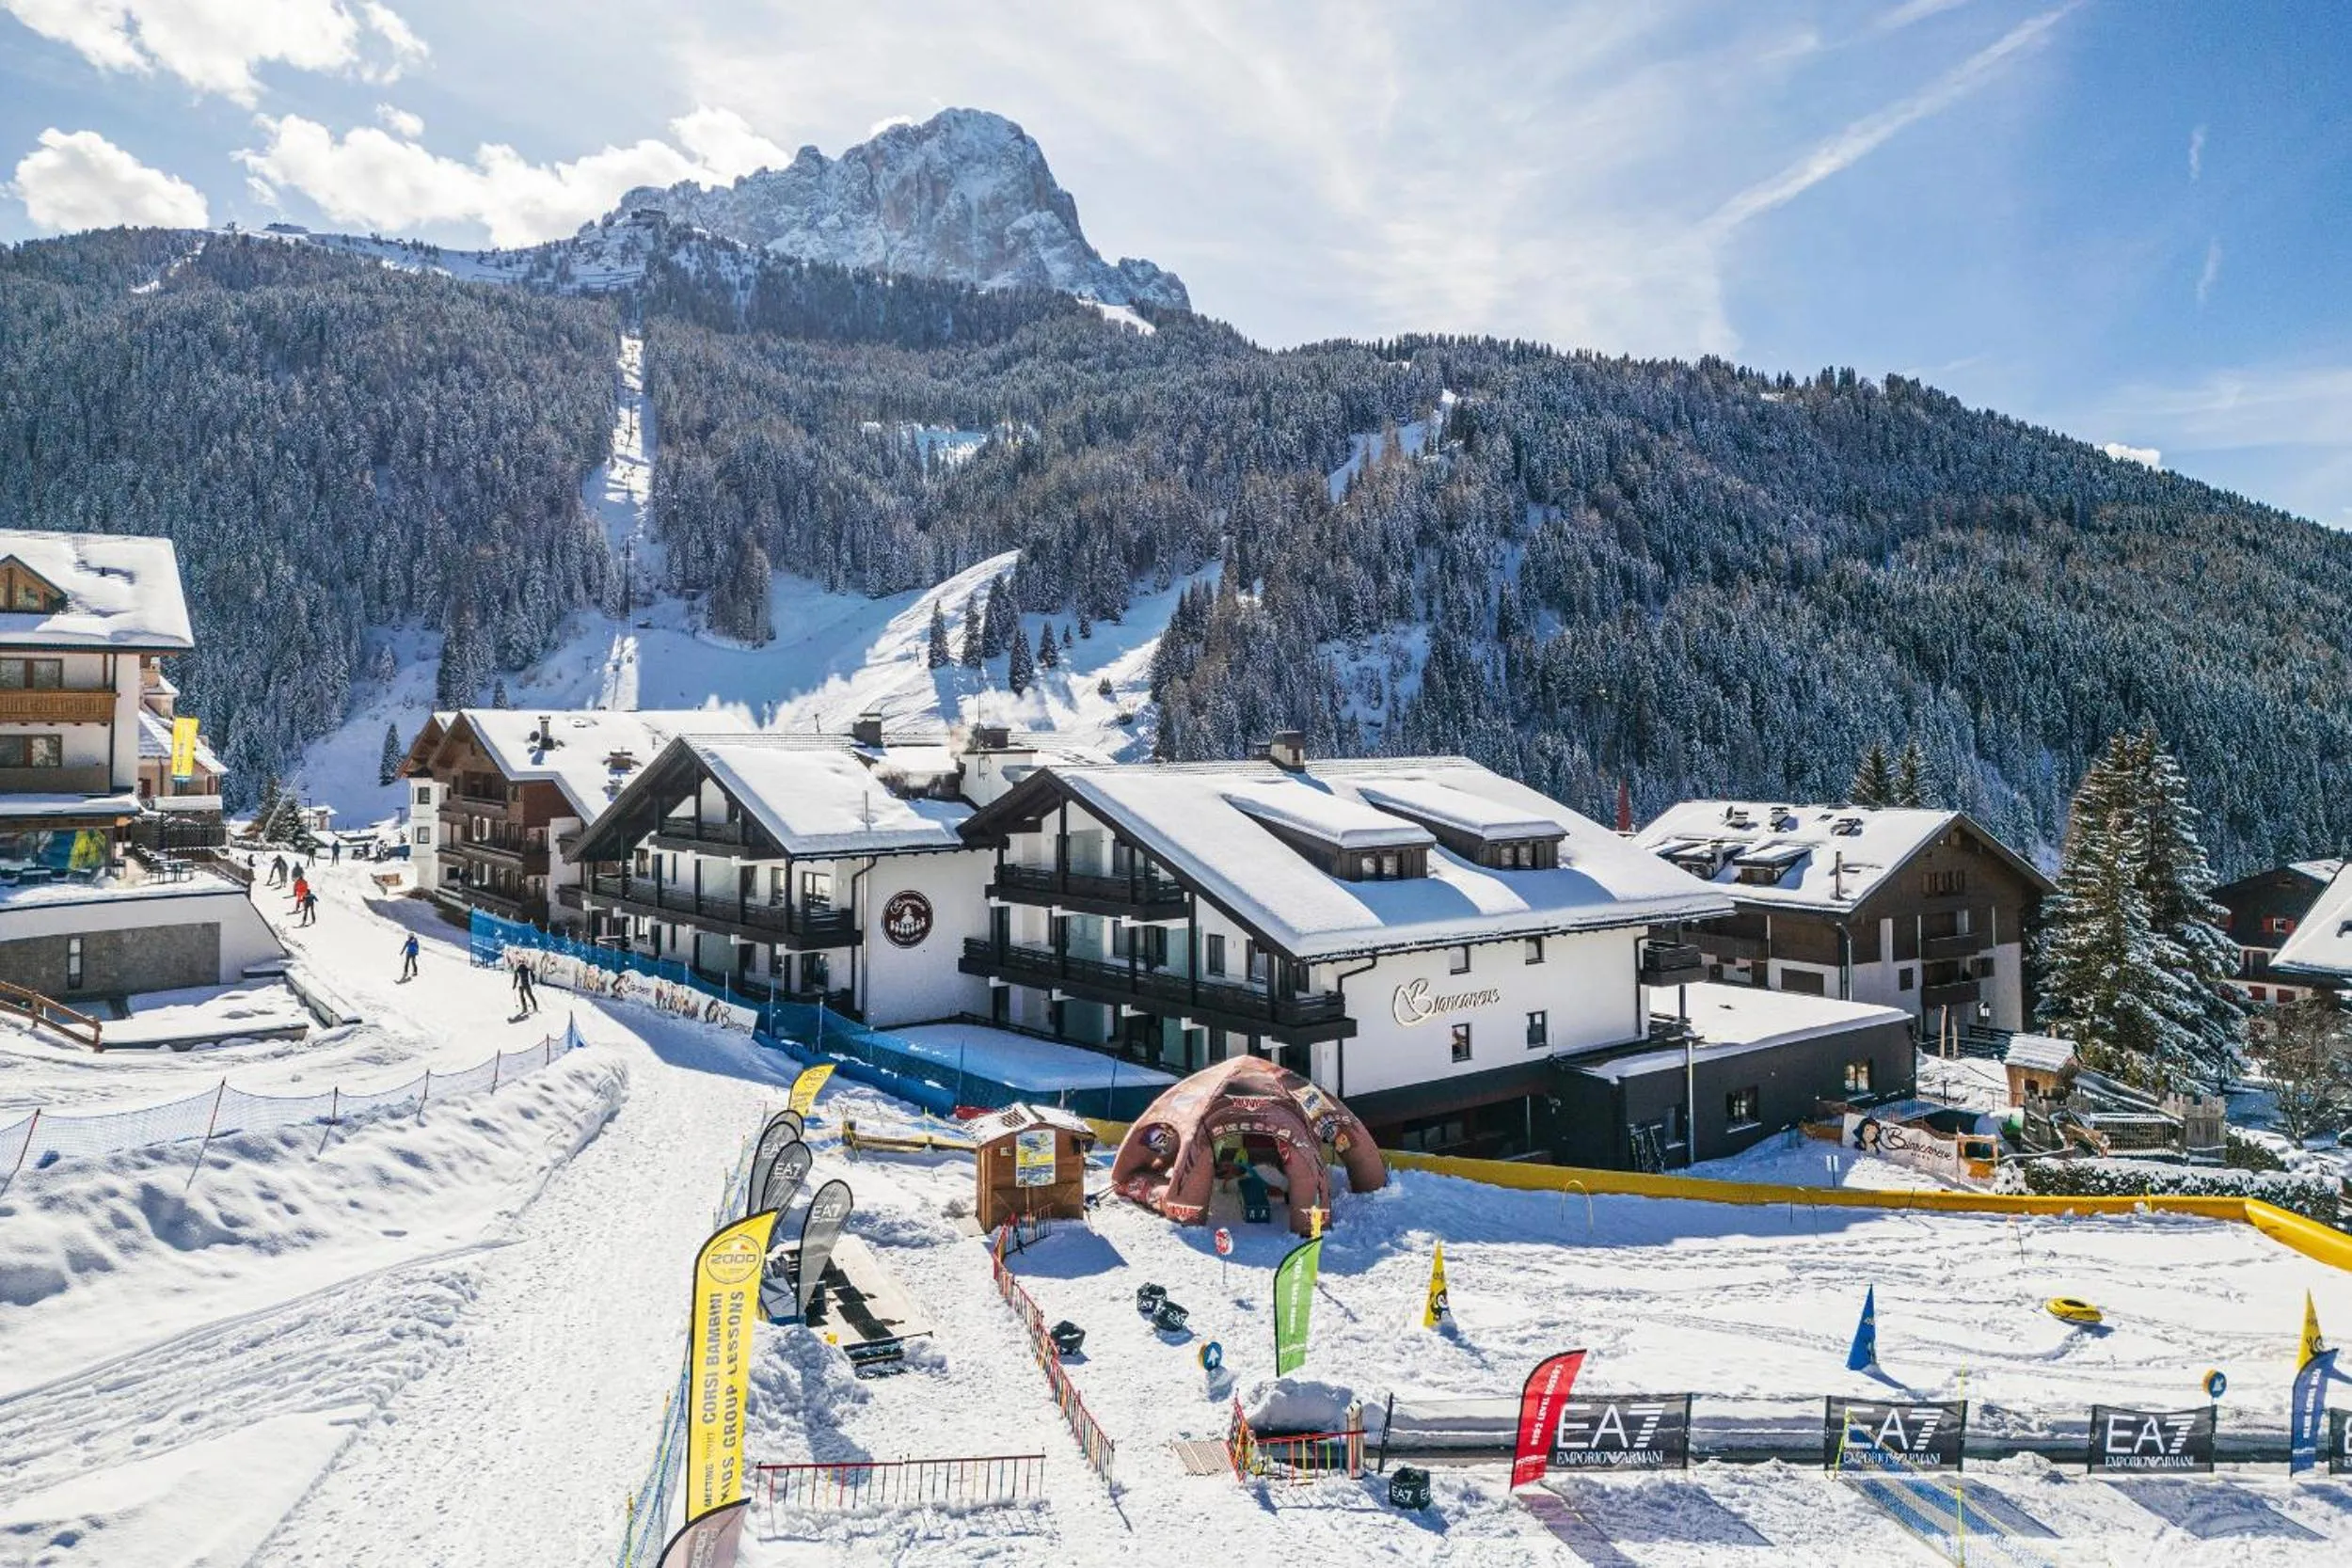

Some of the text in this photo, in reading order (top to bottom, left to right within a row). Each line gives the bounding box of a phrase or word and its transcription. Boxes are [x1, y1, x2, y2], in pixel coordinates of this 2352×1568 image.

[762, 1143, 785, 1158] EA
[774, 1163, 803, 1178] EA7
[812, 1203, 843, 1219] EA7
[706, 1292, 723, 1366] BAMBINI
[726, 1291, 745, 1376] LESSONS
[702, 1372, 721, 1424] CORSI
[723, 1384, 739, 1449] GROUP
[1557, 1402, 1666, 1449] EA7
[1844, 1405, 1944, 1450] EA7
[2106, 1414, 2196, 1454] EA7
[1556, 1450, 1607, 1465] EMPORIO
[1622, 1449, 1663, 1465] ARMANI
[2106, 1455, 2147, 1467] EMPORIO
[721, 1456, 735, 1503] KIDS
[1392, 1485, 1413, 1502] EA7
